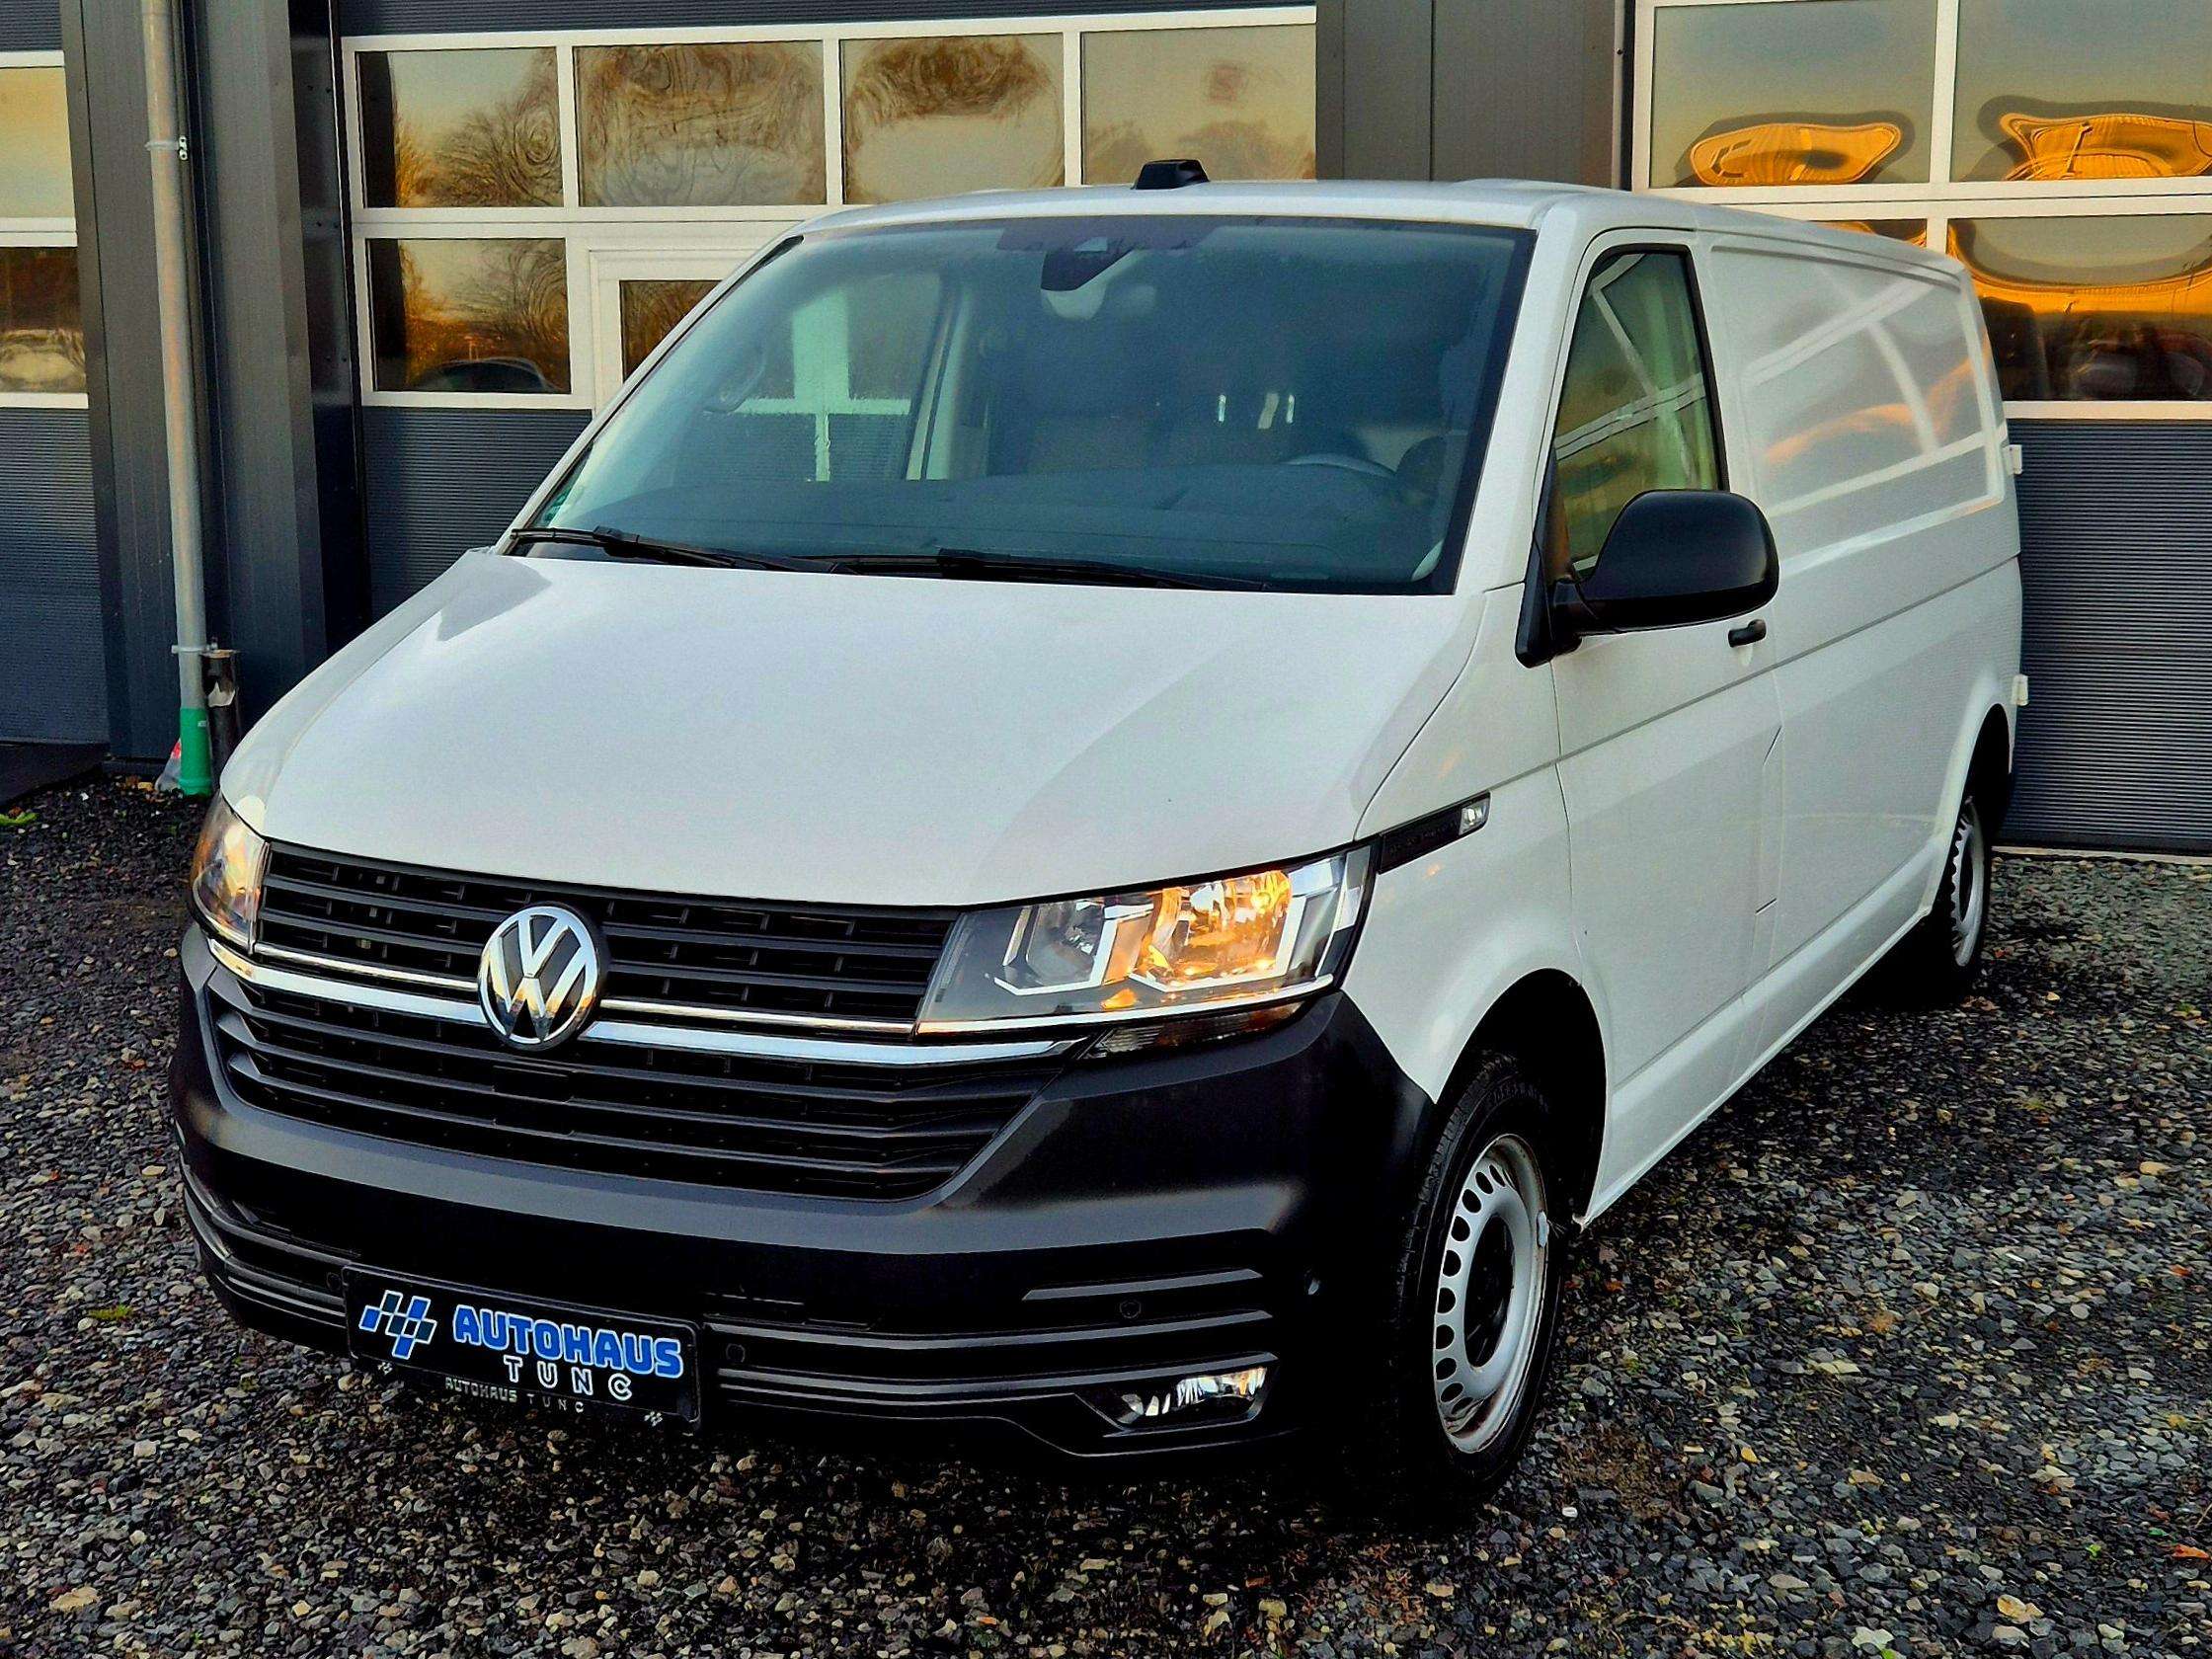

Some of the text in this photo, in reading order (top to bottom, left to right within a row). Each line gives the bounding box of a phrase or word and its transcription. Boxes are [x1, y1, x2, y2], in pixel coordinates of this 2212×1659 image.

[479, 906, 598, 1045] VW
[452, 1304, 684, 1379] AUTOHAUS
[444, 1376, 518, 1403] AUTOHAUS
